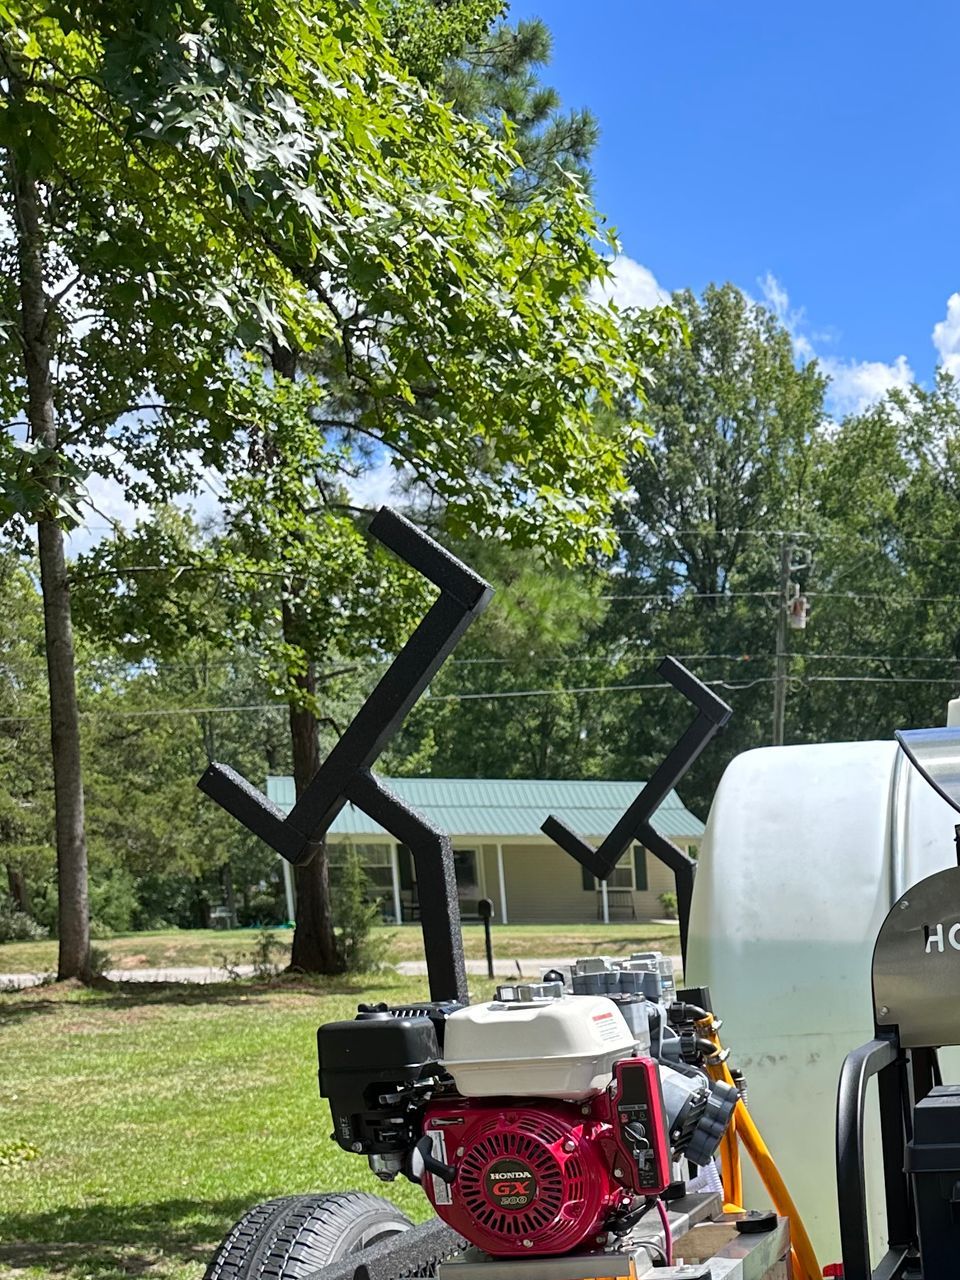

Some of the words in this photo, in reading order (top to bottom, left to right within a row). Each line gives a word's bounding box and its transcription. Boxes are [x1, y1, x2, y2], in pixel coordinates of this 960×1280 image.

[490, 1171, 532, 1180] HONDA
[493, 1181, 529, 1195] GX
[501, 1196, 528, 1205] 200
